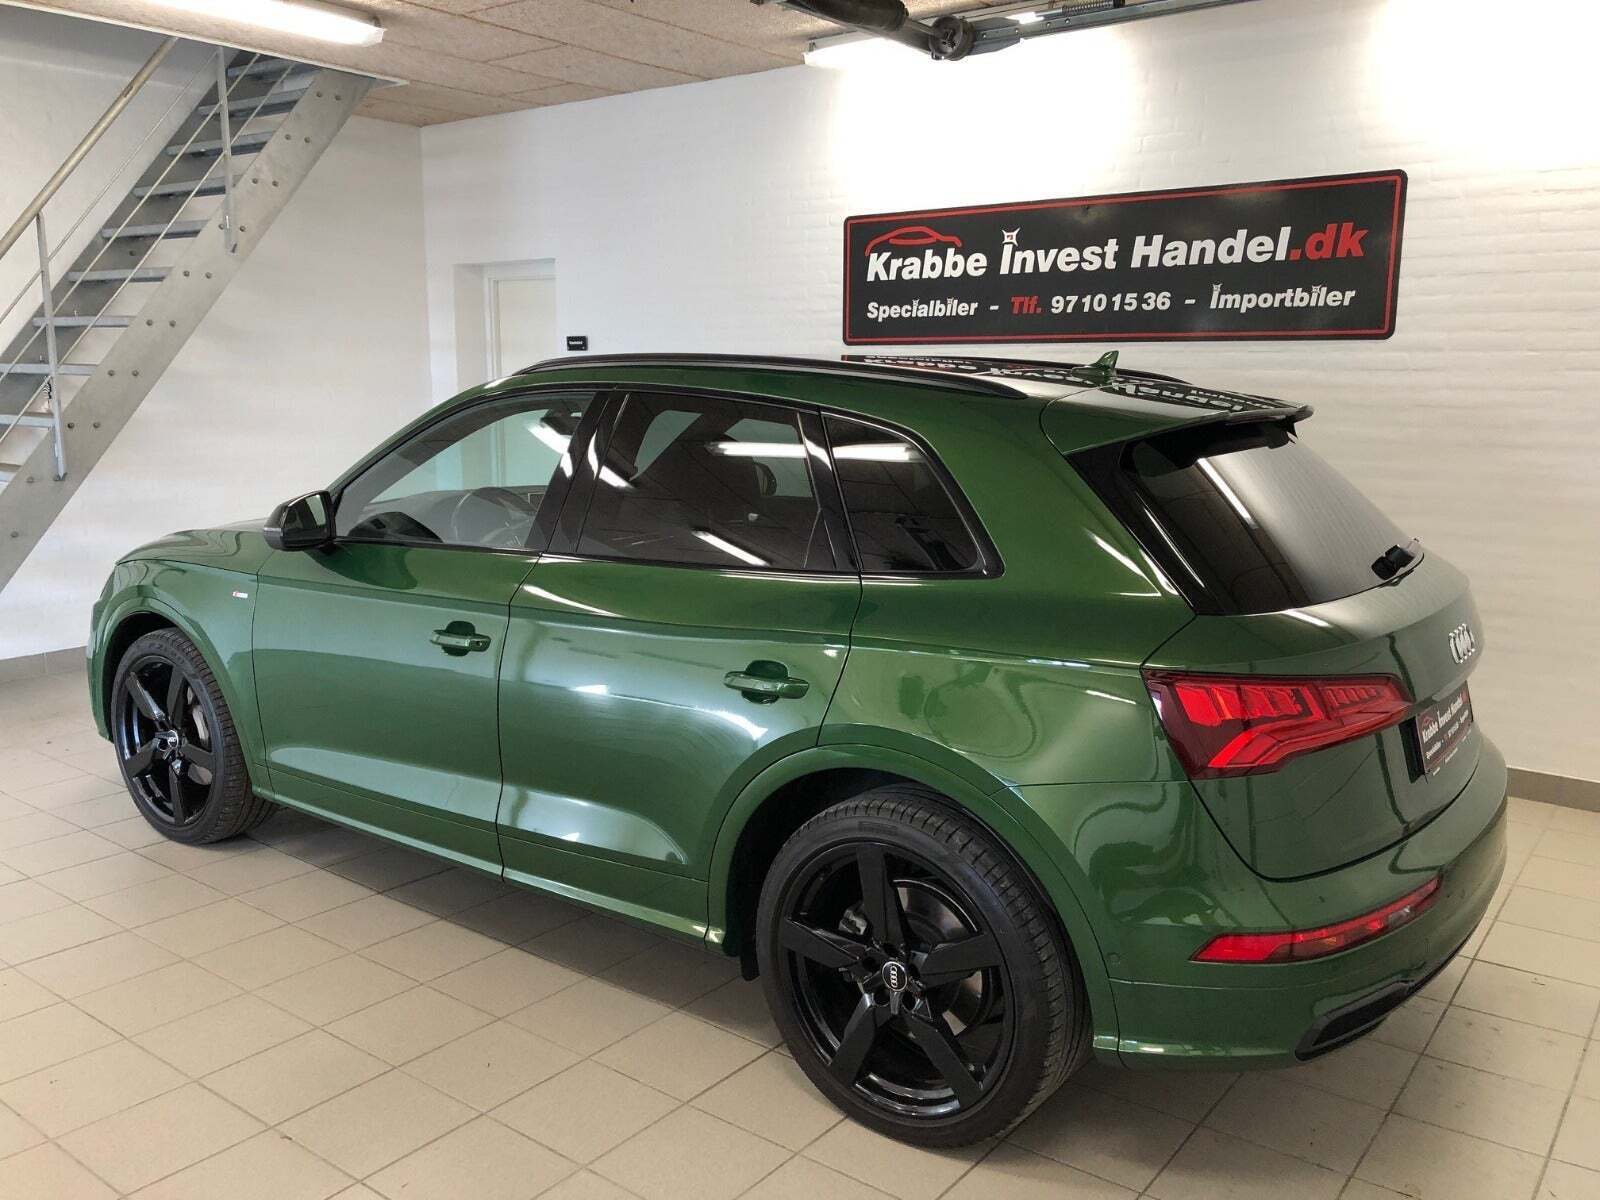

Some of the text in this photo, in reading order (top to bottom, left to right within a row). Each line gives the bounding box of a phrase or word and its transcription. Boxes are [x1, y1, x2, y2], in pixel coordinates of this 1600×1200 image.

[866, 222, 1369, 282] Krabbe Invest Handel.dk
[866, 298, 978, 322] Specialbiler
[1010, 295, 1042, 315] Tlf.
[1209, 283, 1356, 313] Importbiler
